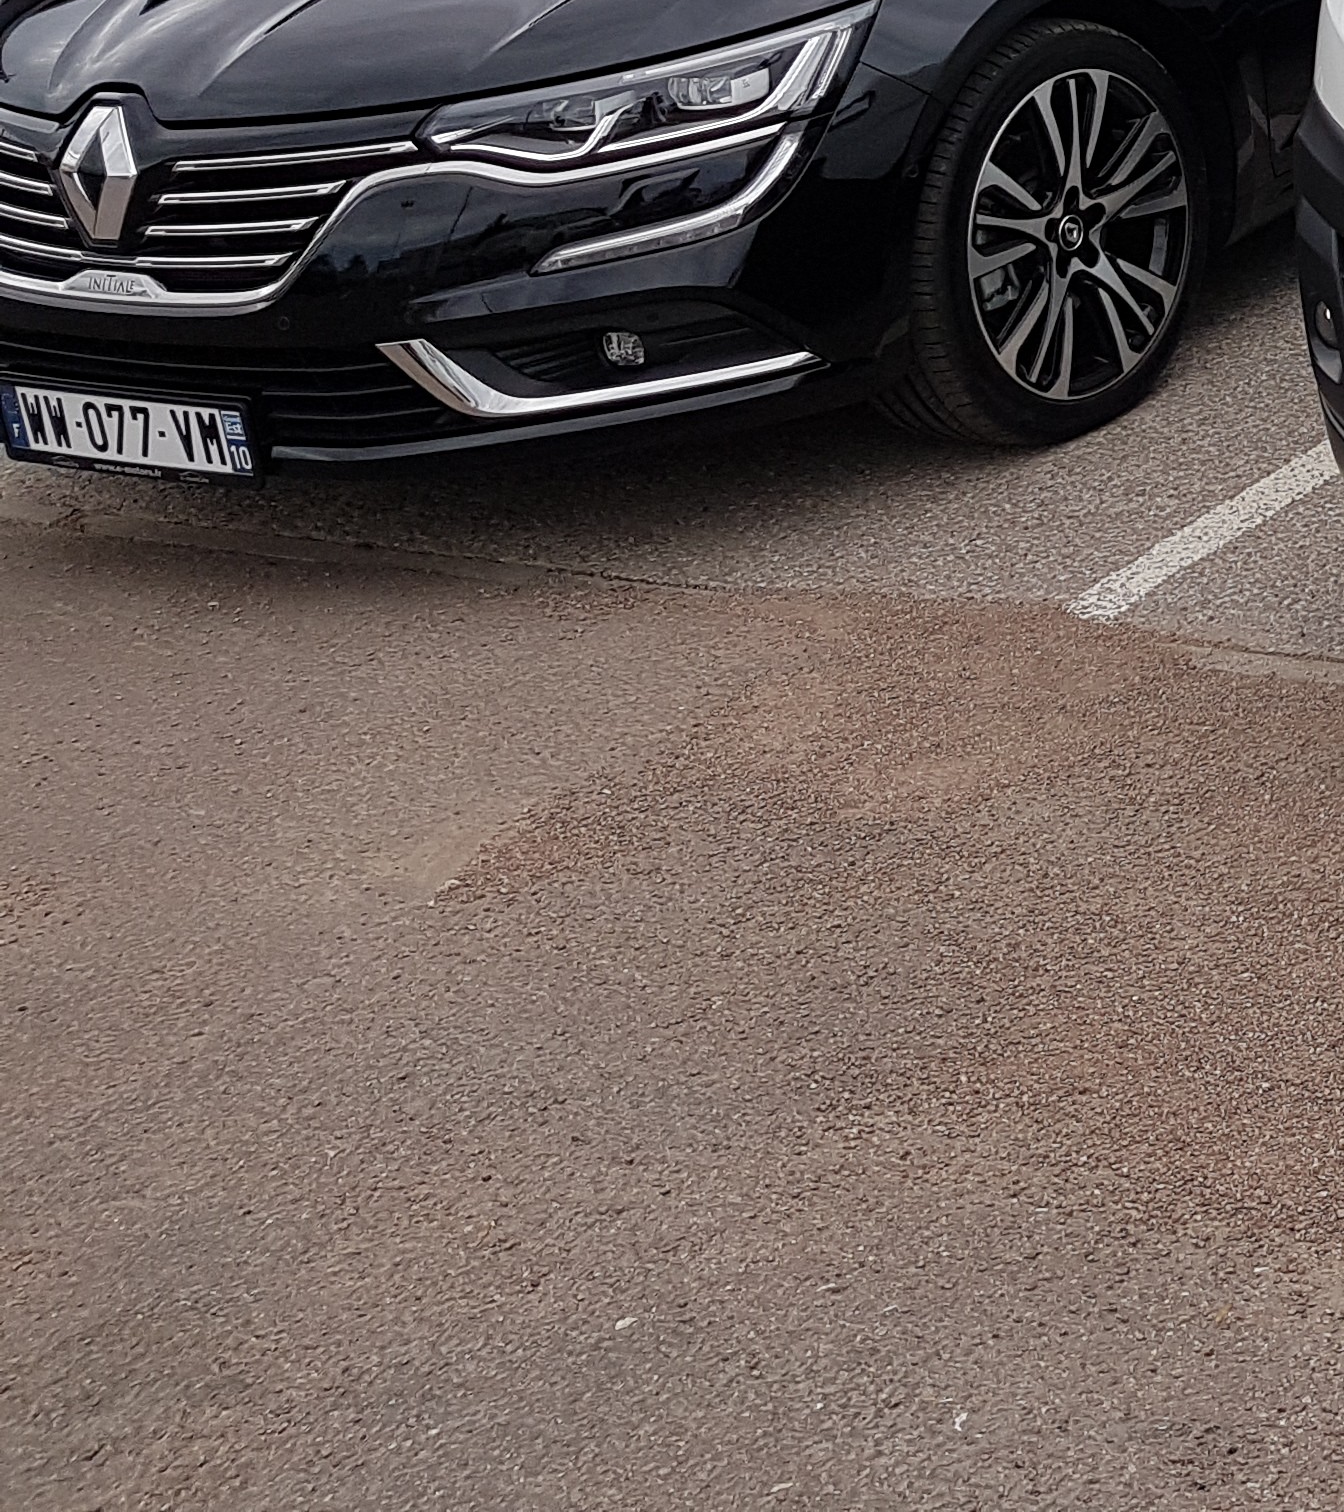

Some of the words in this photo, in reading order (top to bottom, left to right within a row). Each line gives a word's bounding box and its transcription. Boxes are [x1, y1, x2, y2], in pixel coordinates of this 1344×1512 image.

[88, 274, 135, 294] INITIALE
[12, 423, 20, 438] F
[20, 392, 228, 466] WW-077-VM
[231, 445, 252, 470] 10
